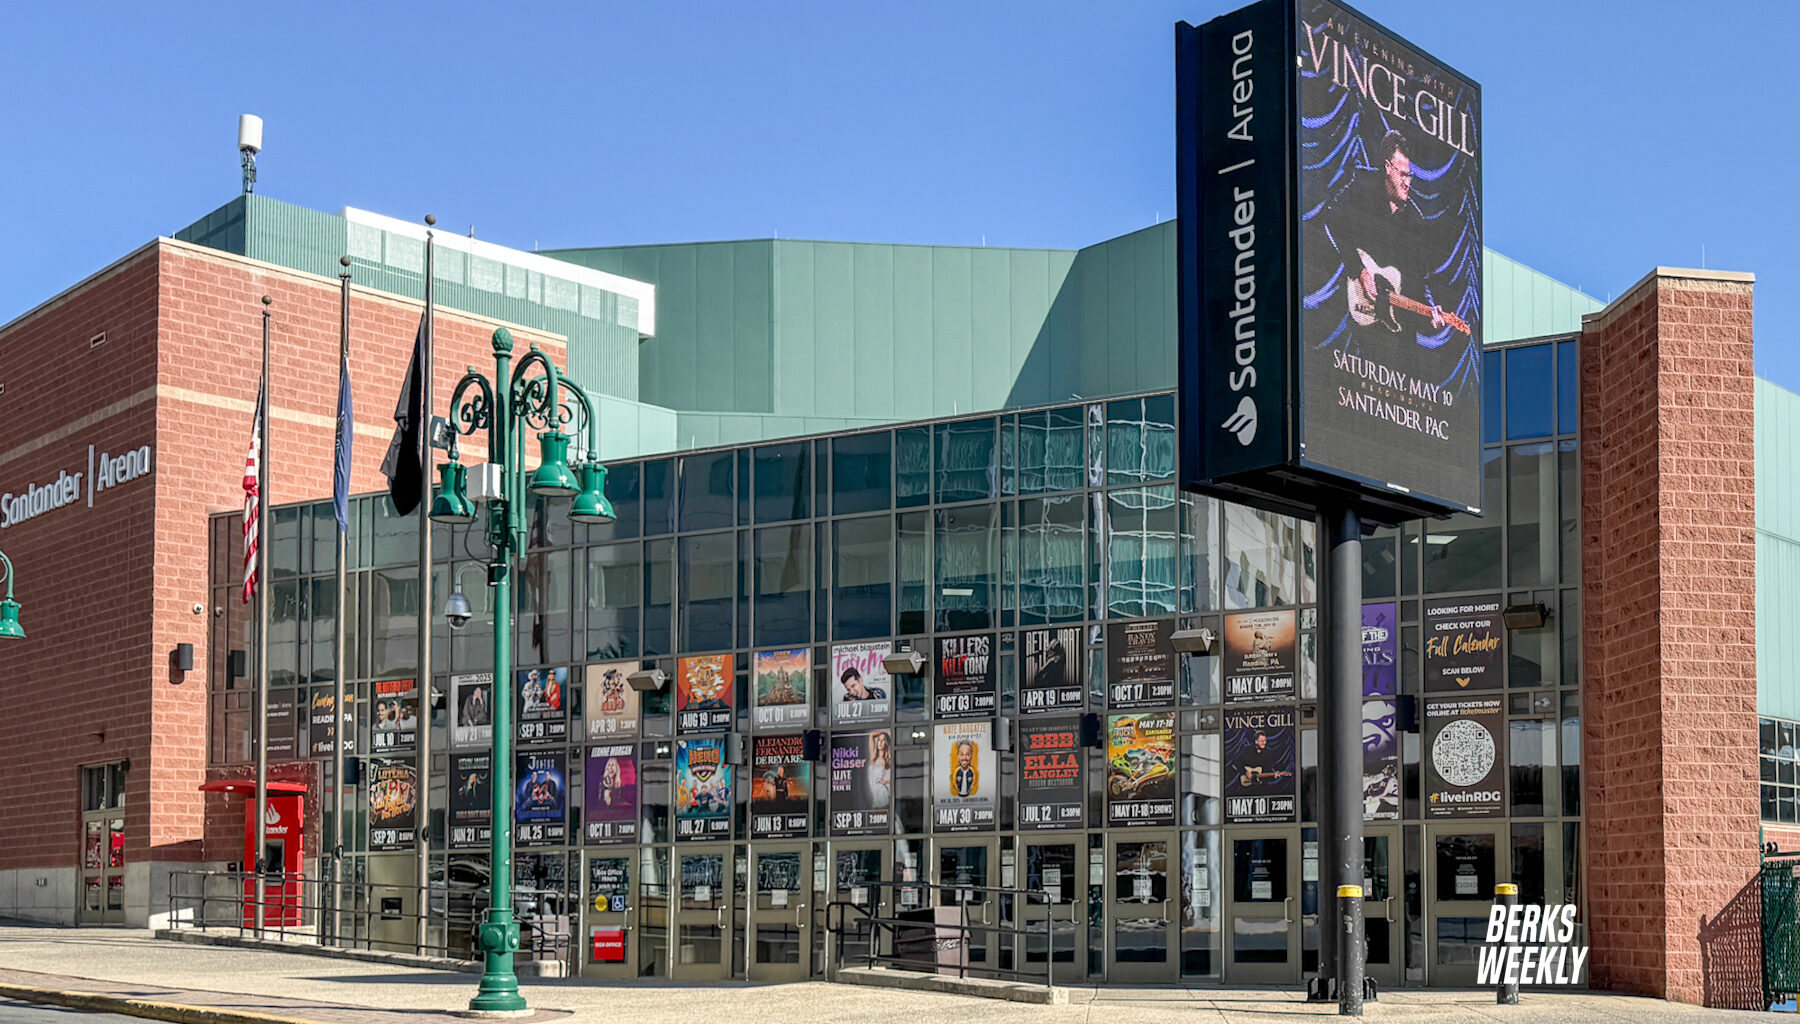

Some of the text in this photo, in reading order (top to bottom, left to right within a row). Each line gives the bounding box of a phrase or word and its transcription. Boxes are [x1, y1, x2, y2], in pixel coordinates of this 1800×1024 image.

[1355, 32, 1414, 76] EVENING
[1302, 19, 1475, 158] VINCE GILL
[1226, 29, 1256, 392] Santander Arena
[1408, 377, 1441, 404] MAY
[1441, 389, 1453, 407] 10
[1338, 386, 1449, 440] SANTANDER PAC
[0, 444, 151, 529] Santander Arena
[1427, 603, 1500, 616] LOOKING FOR MORE?
[1434, 620, 1492, 631] CHECK OUT OUR
[1370, 629, 1387, 641] THE
[834, 643, 891, 654] michael blaustein
[941, 636, 990, 659] KILLERS
[1426, 630, 1500, 659] Full Calendar
[1270, 658, 1280, 666] PA
[475, 673, 492, 683] 2025
[1442, 665, 1486, 676] SCAN BELOW
[1115, 685, 1132, 701] OCT
[1133, 683, 1144, 700] 17
[1231, 677, 1253, 694] MAY
[1254, 676, 1268, 693] 04
[940, 696, 957, 712] OCT
[957, 694, 970, 711] 03
[1026, 690, 1045, 707] APR
[1045, 689, 1056, 706] 19
[1427, 702, 1440, 710] GET
[758, 707, 784, 723] OCT 01
[837, 703, 851, 719] JUL
[851, 702, 863, 717] 27
[1427, 709, 1450, 717] ONLINE
[590, 718, 617, 734] APR 30
[682, 711, 709, 728] AUG 19
[1138, 720, 1155, 729] MAY
[1225, 713, 1294, 729] VINCE GILL
[455, 726, 478, 742] NOV 21
[521, 722, 544, 738] SEP 19
[375, 732, 395, 747] JUL 10
[1029, 732, 1074, 750] BBB
[609, 744, 634, 757] MORGAN
[688, 748, 720, 766] HERO
[832, 746, 860, 759] Nikki
[755, 755, 767, 765] DE
[767, 755, 783, 764] REY
[832, 758, 867, 769] Glaser
[1023, 753, 1080, 771] ELLA
[1023, 768, 1080, 780] LANGLEY
[1429, 790, 1501, 804] #liveinRDG
[1025, 805, 1040, 822] JUL
[1041, 805, 1052, 821] 12
[1114, 804, 1131, 818] MAY
[1131, 803, 1149, 817] 17-18
[1232, 798, 1253, 816] MAY
[1254, 797, 1266, 815] 10
[757, 815, 782, 832] JUN 13
[836, 813, 852, 828] SEP
[852, 812, 863, 827] 18
[939, 809, 959, 825] MAY
[959, 808, 971, 824] 30
[266, 825, 288, 835] tander
[453, 827, 475, 842] JUN 21
[520, 825, 543, 840] JUL 25
[589, 823, 604, 838] OCT
[604, 822, 611, 837] 11
[680, 819, 705, 835] JUL 27
[374, 829, 396, 845] SEP 20
